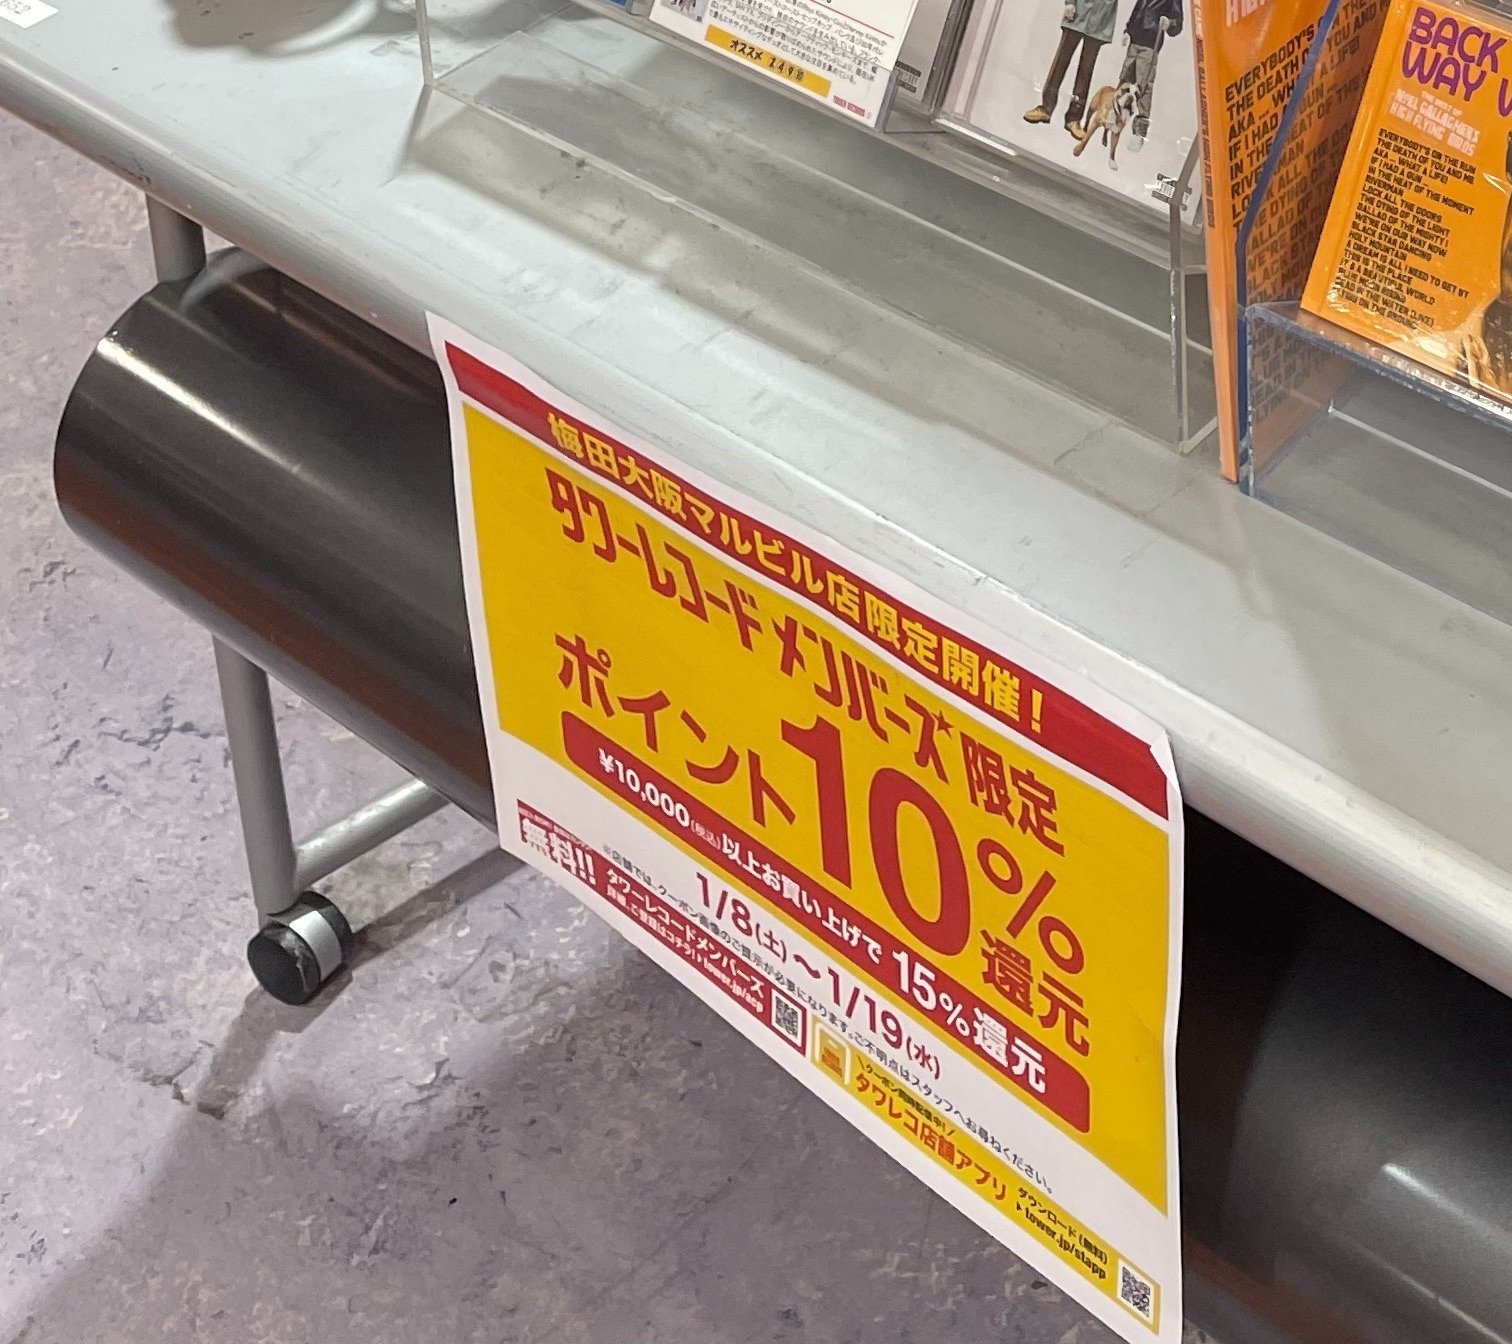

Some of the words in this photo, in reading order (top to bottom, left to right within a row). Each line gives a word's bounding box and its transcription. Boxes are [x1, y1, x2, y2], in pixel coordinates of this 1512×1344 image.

[1225, 22, 1314, 104] EVERYBODY'S
[1226, 88, 1253, 123] THE
[1256, 54, 1298, 101] DEATH
[1402, 41, 1487, 102] WAY
[1408, 7, 1508, 74] BACK
[549, 410, 1044, 733] 梅田大阪マルビル店限定開催！
[554, 633, 798, 828] ポイント
[980, 930, 1090, 1057] 還元
[606, 868, 766, 1000] タワーレコードメンバーズ
[854, 1072, 1008, 1201] タワレコ店舗アプリ
